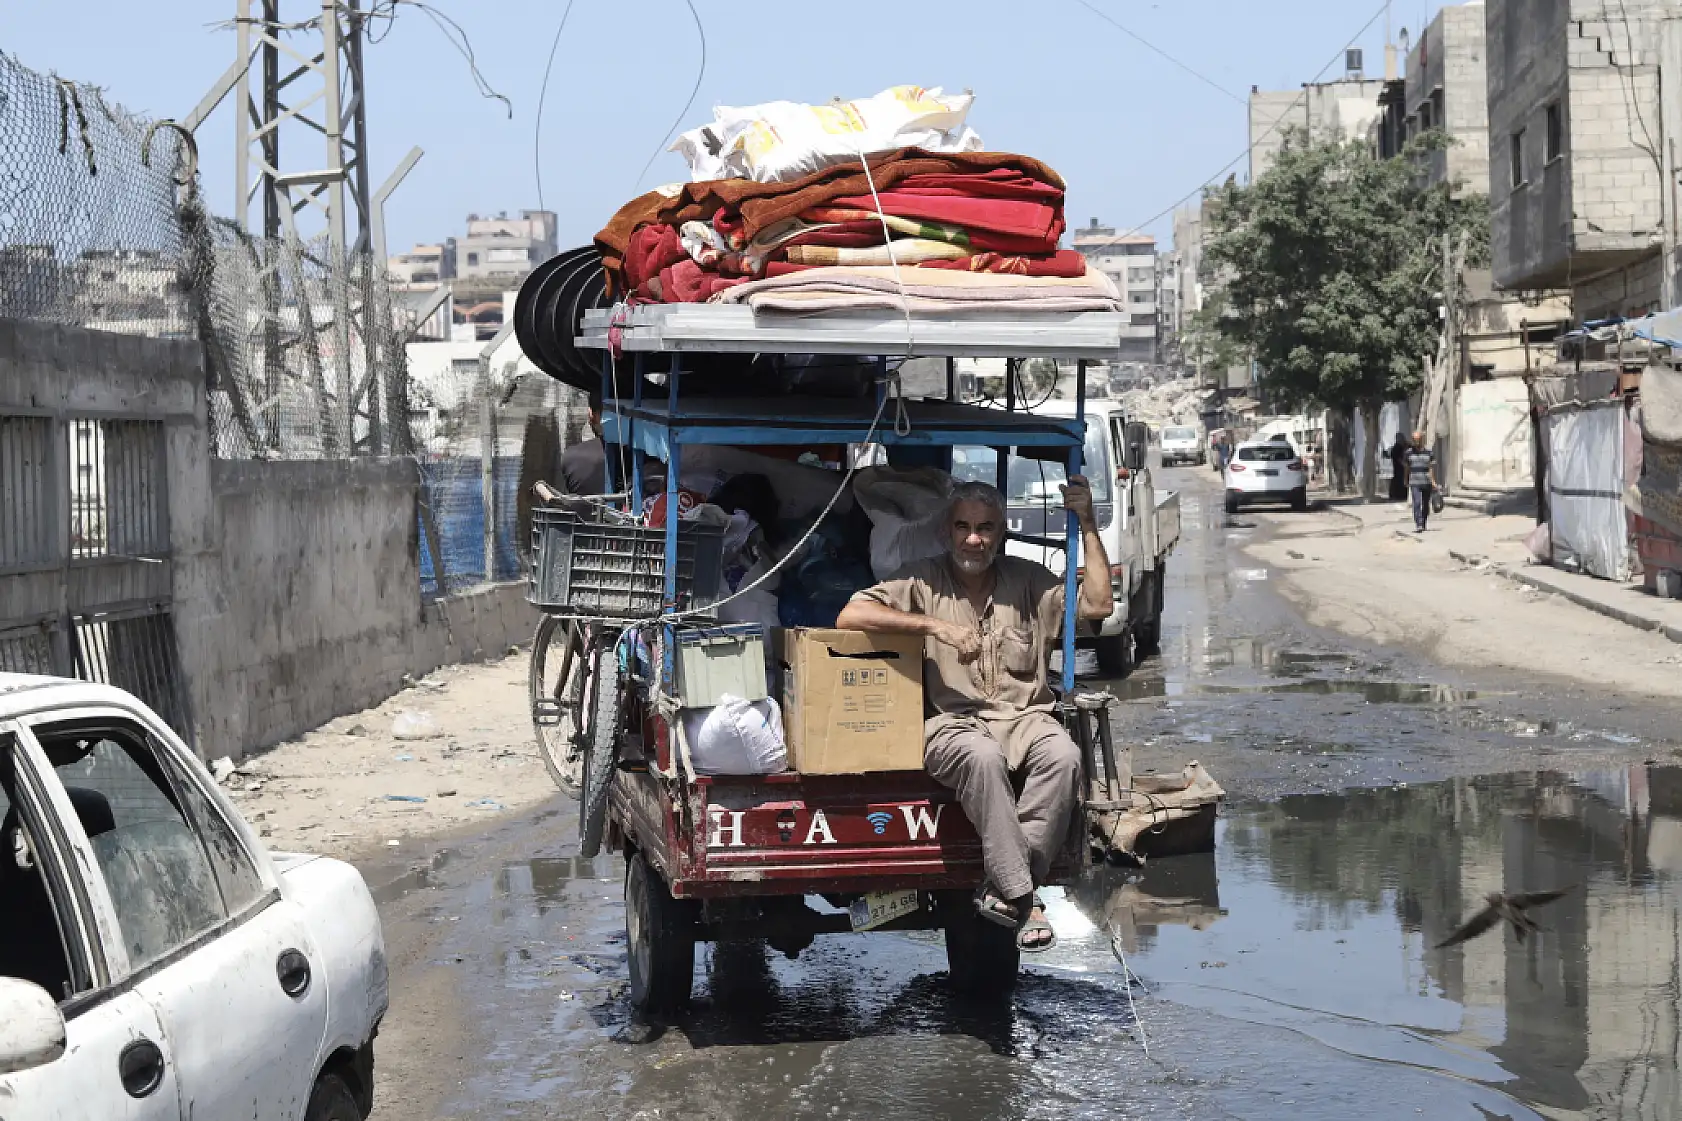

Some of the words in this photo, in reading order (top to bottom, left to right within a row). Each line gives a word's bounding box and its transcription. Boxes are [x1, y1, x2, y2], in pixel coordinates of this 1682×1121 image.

[708, 811, 746, 847] H
[804, 808, 837, 844] A
[898, 803, 946, 841] W
